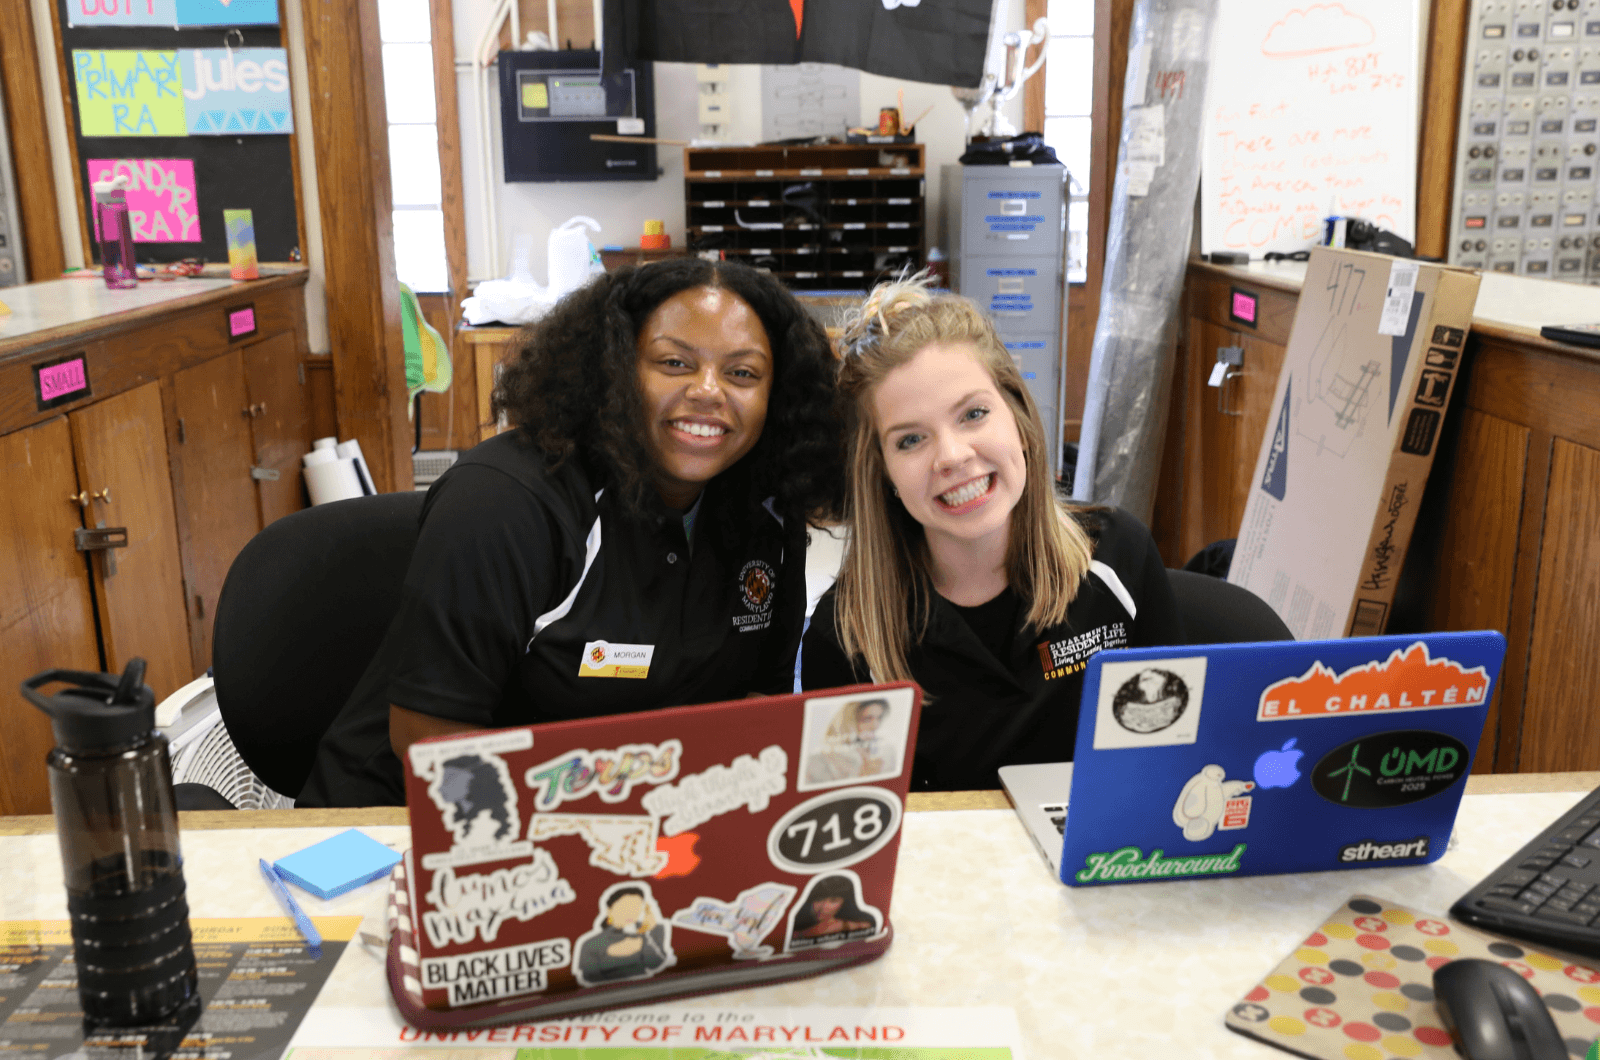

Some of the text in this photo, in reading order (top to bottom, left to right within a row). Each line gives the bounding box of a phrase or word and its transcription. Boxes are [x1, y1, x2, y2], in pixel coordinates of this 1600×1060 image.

[74, 52, 179, 99] PRIMARY
[113, 104, 158, 134] RA
[1287, 130, 1321, 148] are
[1332, 123, 1374, 141] more
[732, 613, 768, 626] RESIDENT
[1049, 625, 1108, 651] DEPARTMENT
[1052, 628, 1127, 660] RESIDENT LIFE
[613, 651, 647, 659] MORGAN
[1054, 654, 1075, 668] Living
[1264, 683, 1485, 717] EL CHALTÉN
[1379, 746, 1459, 776] UMD
[1400, 782, 1426, 792] 2025
[787, 804, 883, 858] 718
[427, 943, 565, 984] BLACK LIVES
[454, 971, 541, 1002] MATTER
[682, 1012, 705, 1023] to
[716, 1012, 755, 1023] the
[399, 1025, 905, 1042] UNIVERSITY OF MARYLAND
